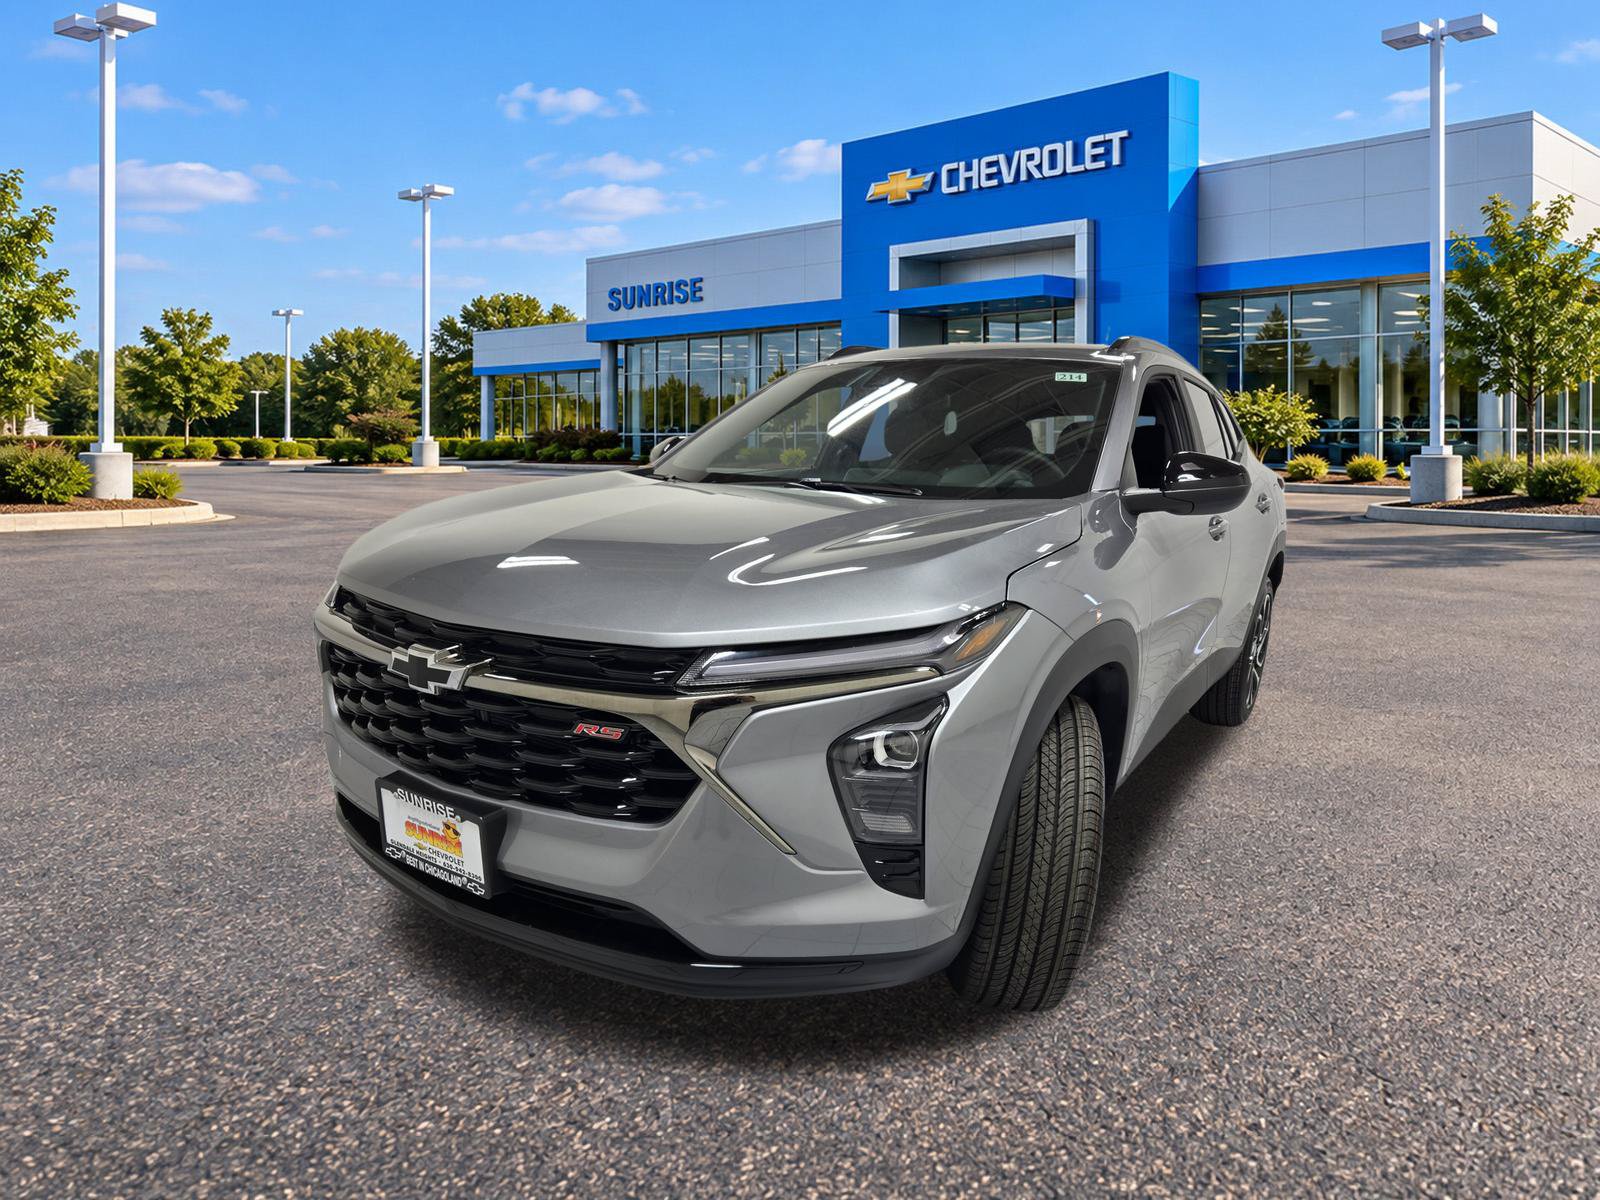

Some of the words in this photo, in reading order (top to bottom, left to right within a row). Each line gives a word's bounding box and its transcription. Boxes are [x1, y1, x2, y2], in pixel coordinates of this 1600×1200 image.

[940, 130, 1129, 194] CHEVROLET
[607, 277, 704, 312] SUNRISE
[573, 723, 624, 740] RS
[396, 788, 455, 818] SUNRISE
[390, 838, 415, 853] GLENDALE
[415, 849, 438, 864] HEIGHTS
[428, 846, 464, 866] CHEVROLET
[406, 855, 418, 869] BEST
[418, 860, 425, 872] IN
[424, 863, 462, 887] CHICAGOLAND
